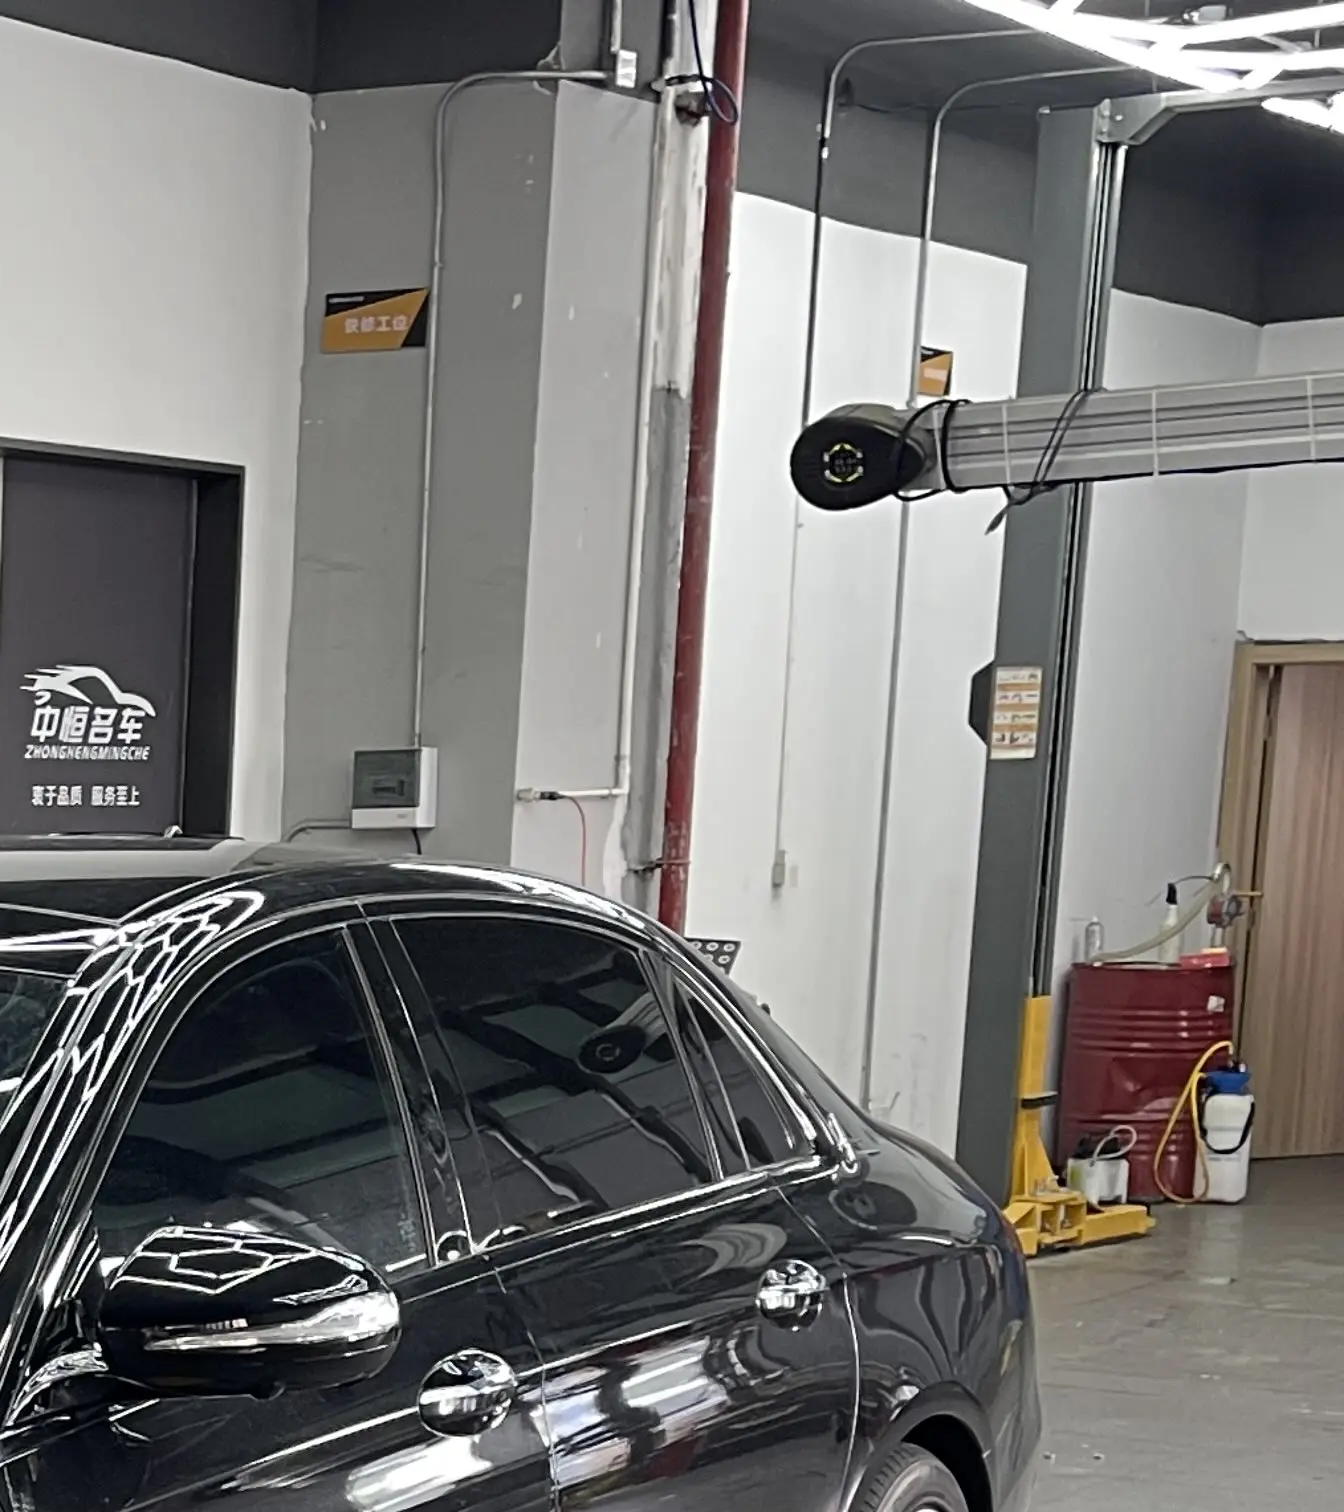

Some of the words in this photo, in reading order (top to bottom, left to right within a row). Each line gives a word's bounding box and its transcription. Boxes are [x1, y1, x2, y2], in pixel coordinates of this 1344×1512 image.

[30, 705, 146, 744] 中恒名车
[24, 744, 151, 760] ZHONGHENGMINGCHE
[90, 785, 141, 806] 服务至上
